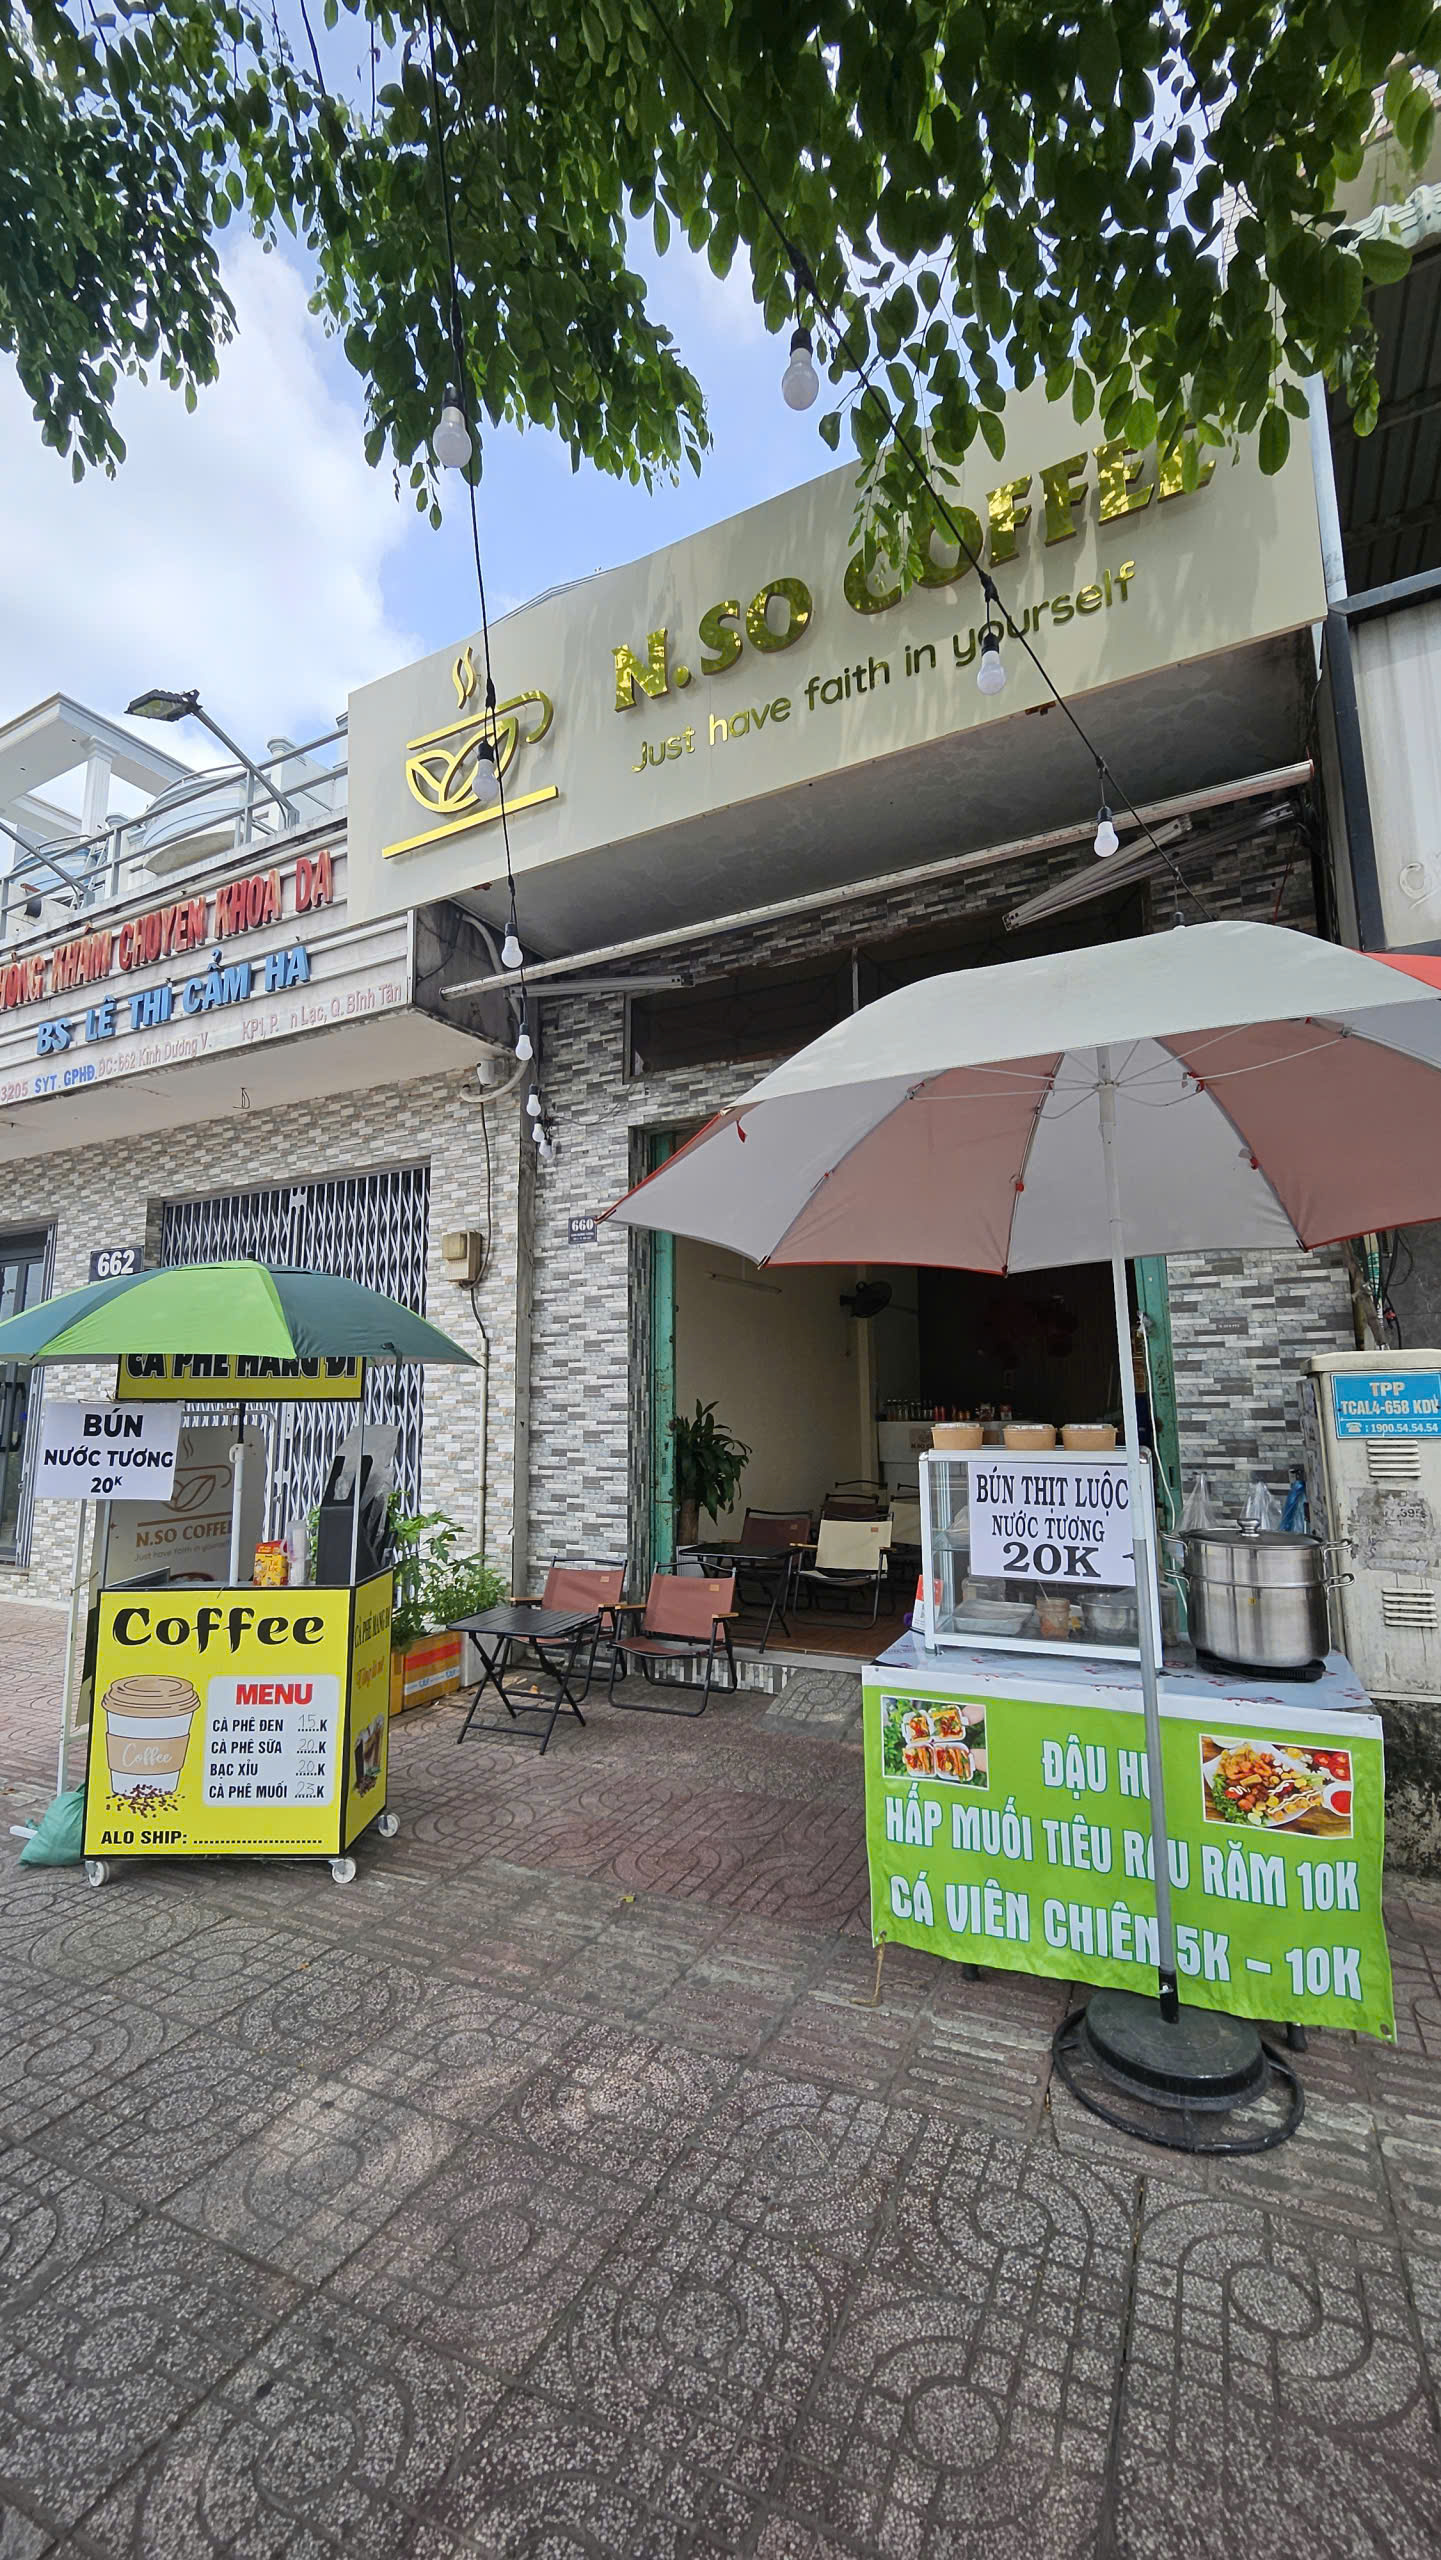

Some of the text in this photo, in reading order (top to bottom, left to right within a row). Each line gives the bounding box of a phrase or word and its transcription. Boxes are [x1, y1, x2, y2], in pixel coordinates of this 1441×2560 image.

[611, 577, 813, 713] N.SO
[709, 697, 791, 746] have
[805, 656, 890, 711] faith
[905, 644, 936, 676] in
[953, 560, 1135, 667] yourself
[214, 868, 282, 940] KHOA
[295, 850, 333, 913] DA
[37, 1017, 72, 1056] BS
[85, 995, 117, 1043] LÊ
[572, 1218, 594, 1231] 660
[98, 1250, 134, 1276] 662
[1369, 1382, 1406, 1396] TPP
[1341, 1400, 1410, 1415] TCAL4-658
[83, 1408, 143, 1437] BÚN
[1371, 1423, 1438, 1432] 1900.54.54.54
[44, 1445, 173, 1467] NƯỚC TƯƠNG
[976, 1466, 1128, 1516] BÚN THỊT LUỘC
[136, 1528, 177, 1547] N.SO
[992, 1510, 1105, 1542] NƯỚC TƯƠNG
[1003, 1542, 1101, 1578] 20K
[113, 1607, 324, 1653] Coffee
[235, 1684, 313, 1705] MENU
[212, 1717, 228, 1732] CÀ
[232, 1717, 255, 1732] PHÊ
[260, 1719, 284, 1732] ĐEN
[122, 1743, 172, 1769] Coffee
[211, 1739, 227, 1754] CÀ
[231, 1739, 254, 1754] PHÊ
[258, 1739, 282, 1754] SỮA
[210, 1763, 234, 1779] BẠC
[238, 1759, 258, 1776] XỈU
[1041, 1734, 1108, 1800] ĐẬU
[209, 1783, 224, 1798] CÀ
[229, 1783, 252, 1798] PHÊ
[256, 1780, 287, 1798] MUỐI
[101, 1831, 188, 1844] ALO SHIP:
[885, 1782, 942, 1847] HẤP
[951, 1795, 1033, 1861] MUỐI
[1041, 1814, 1112, 1874] TIÊU
[1201, 1840, 1287, 1908] RĂM
[1296, 1861, 1360, 1911] 10K
[890, 1870, 935, 1927] CÁ
[945, 1878, 1030, 1942] VIÊN
[1043, 1901, 1160, 1966] CHIÊN
[1176, 1924, 1231, 1982] 5K
[1285, 1946, 1363, 2002] 10K
